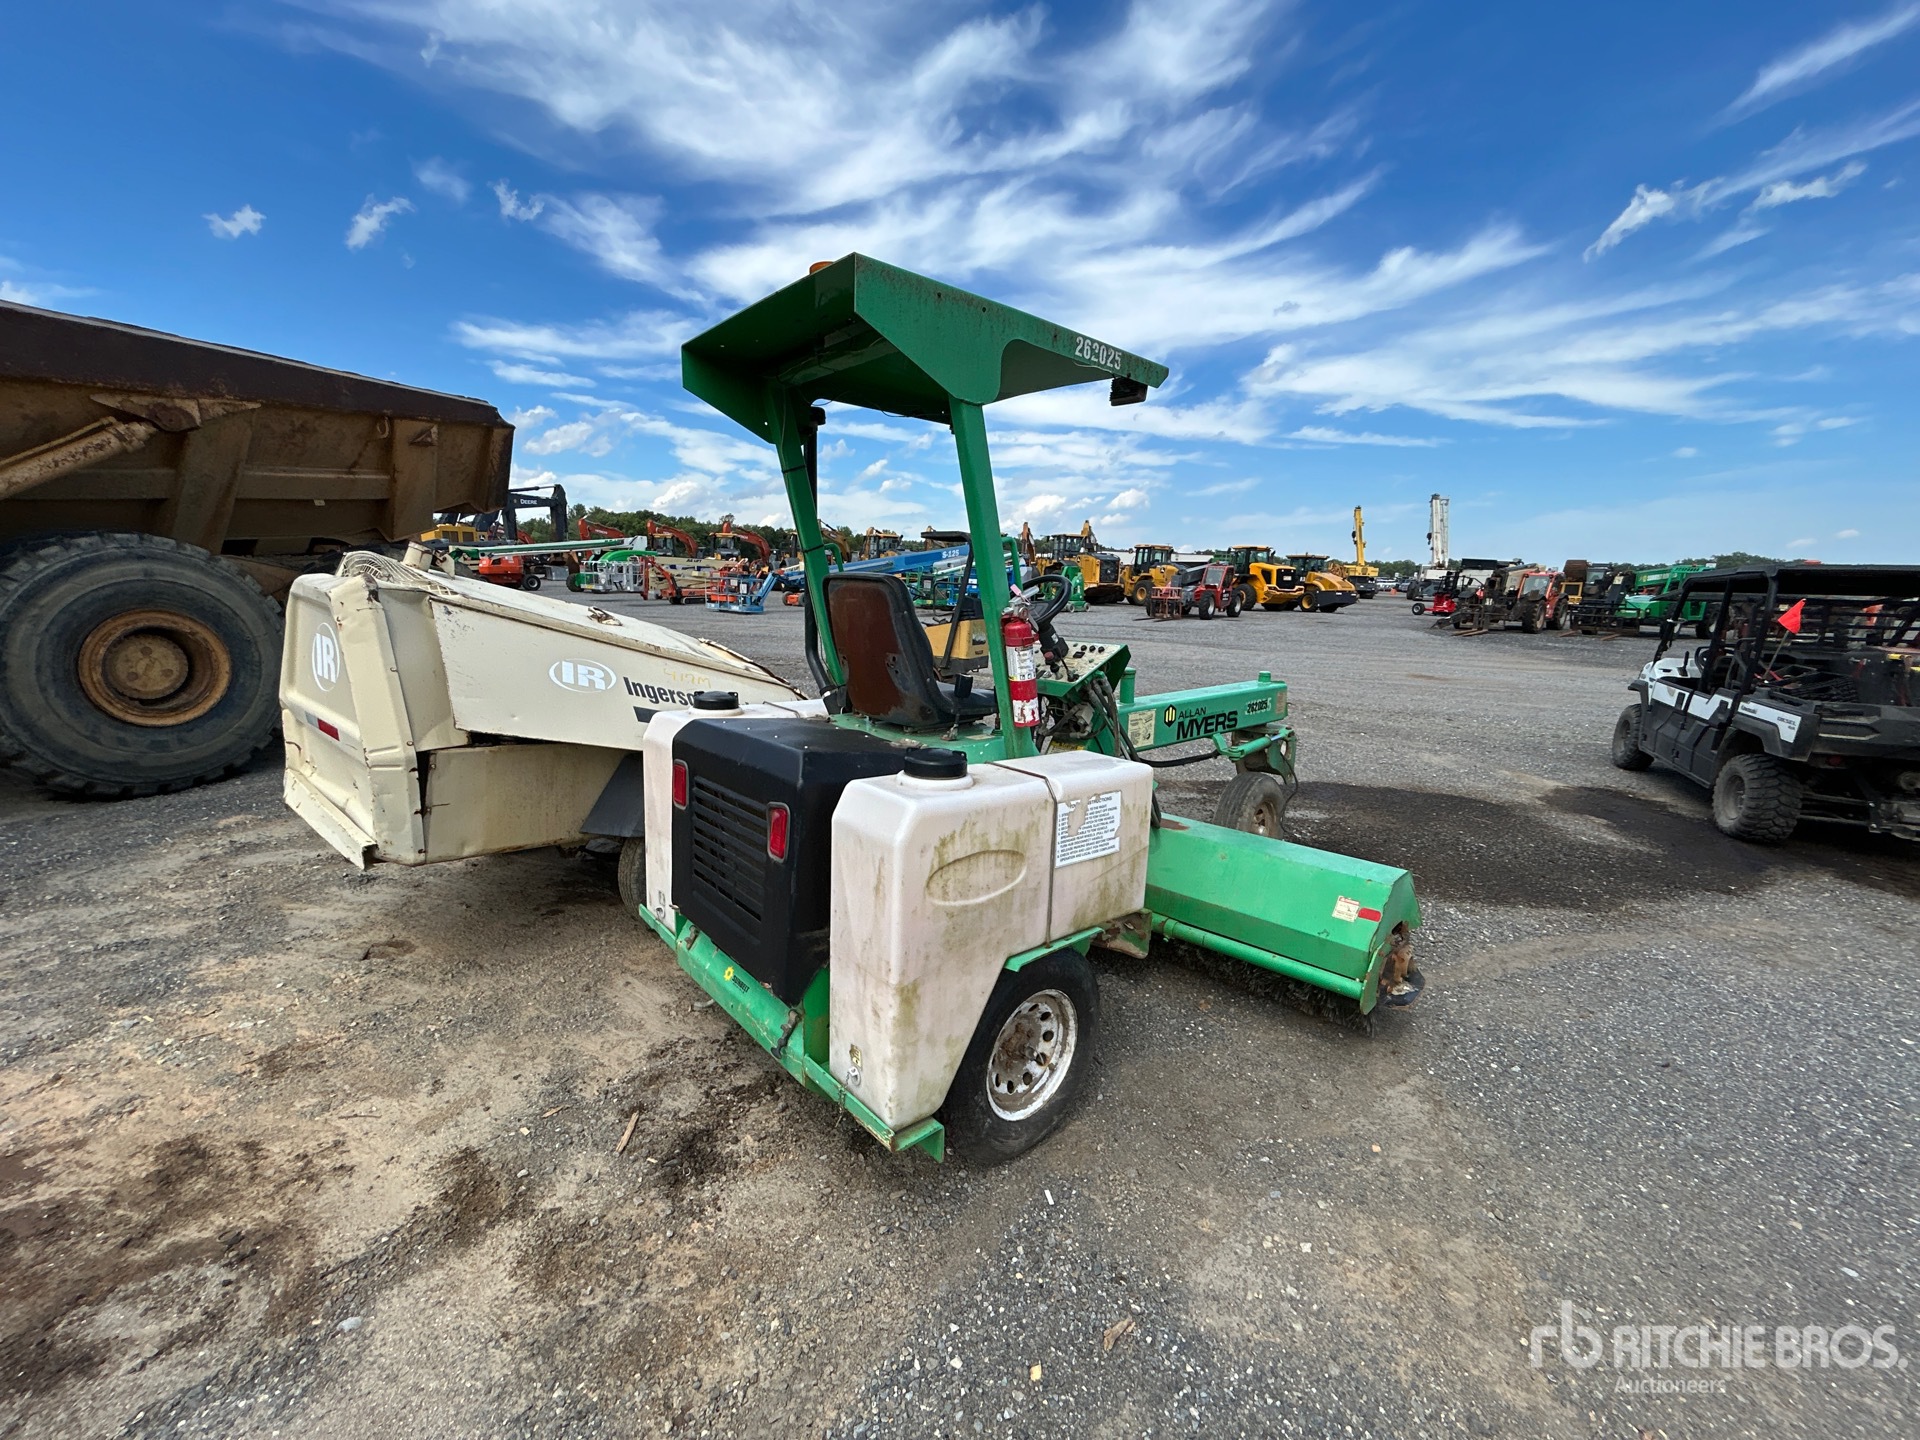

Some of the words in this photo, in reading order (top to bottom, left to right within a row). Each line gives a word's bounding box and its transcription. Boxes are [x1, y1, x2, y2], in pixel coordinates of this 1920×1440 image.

[1074, 336, 1122, 370] 262025
[942, 550, 960, 559] S-125
[315, 632, 337, 684] IR
[560, 660, 606, 691] IR
[622, 676, 695, 706] Ingerso
[1176, 710, 1238, 740] MYERS
[1178, 706, 1207, 720] ALLAN
